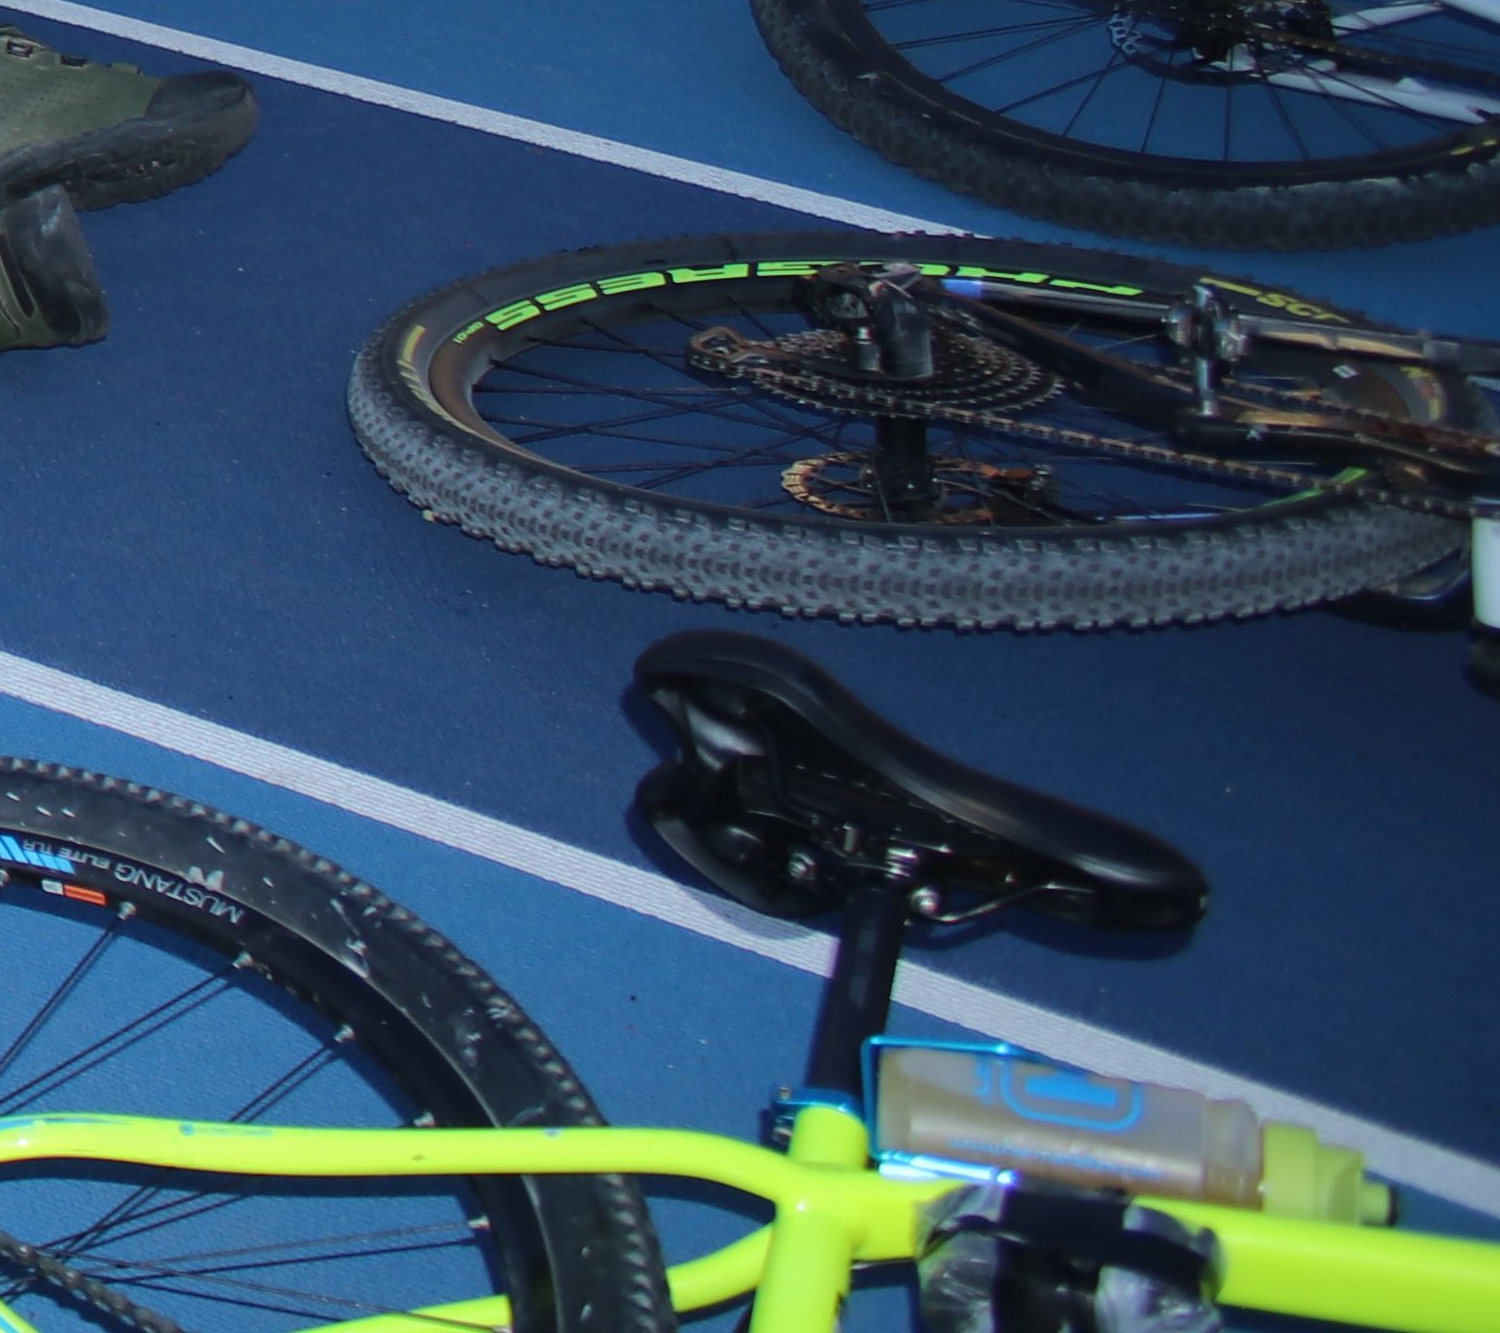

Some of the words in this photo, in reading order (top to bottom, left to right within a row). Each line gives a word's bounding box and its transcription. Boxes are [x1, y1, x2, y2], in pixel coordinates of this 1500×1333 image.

[17, 836, 46, 858] TLR
[45, 842, 110, 876] ELITE
[111, 849, 242, 926] MUSTANG
